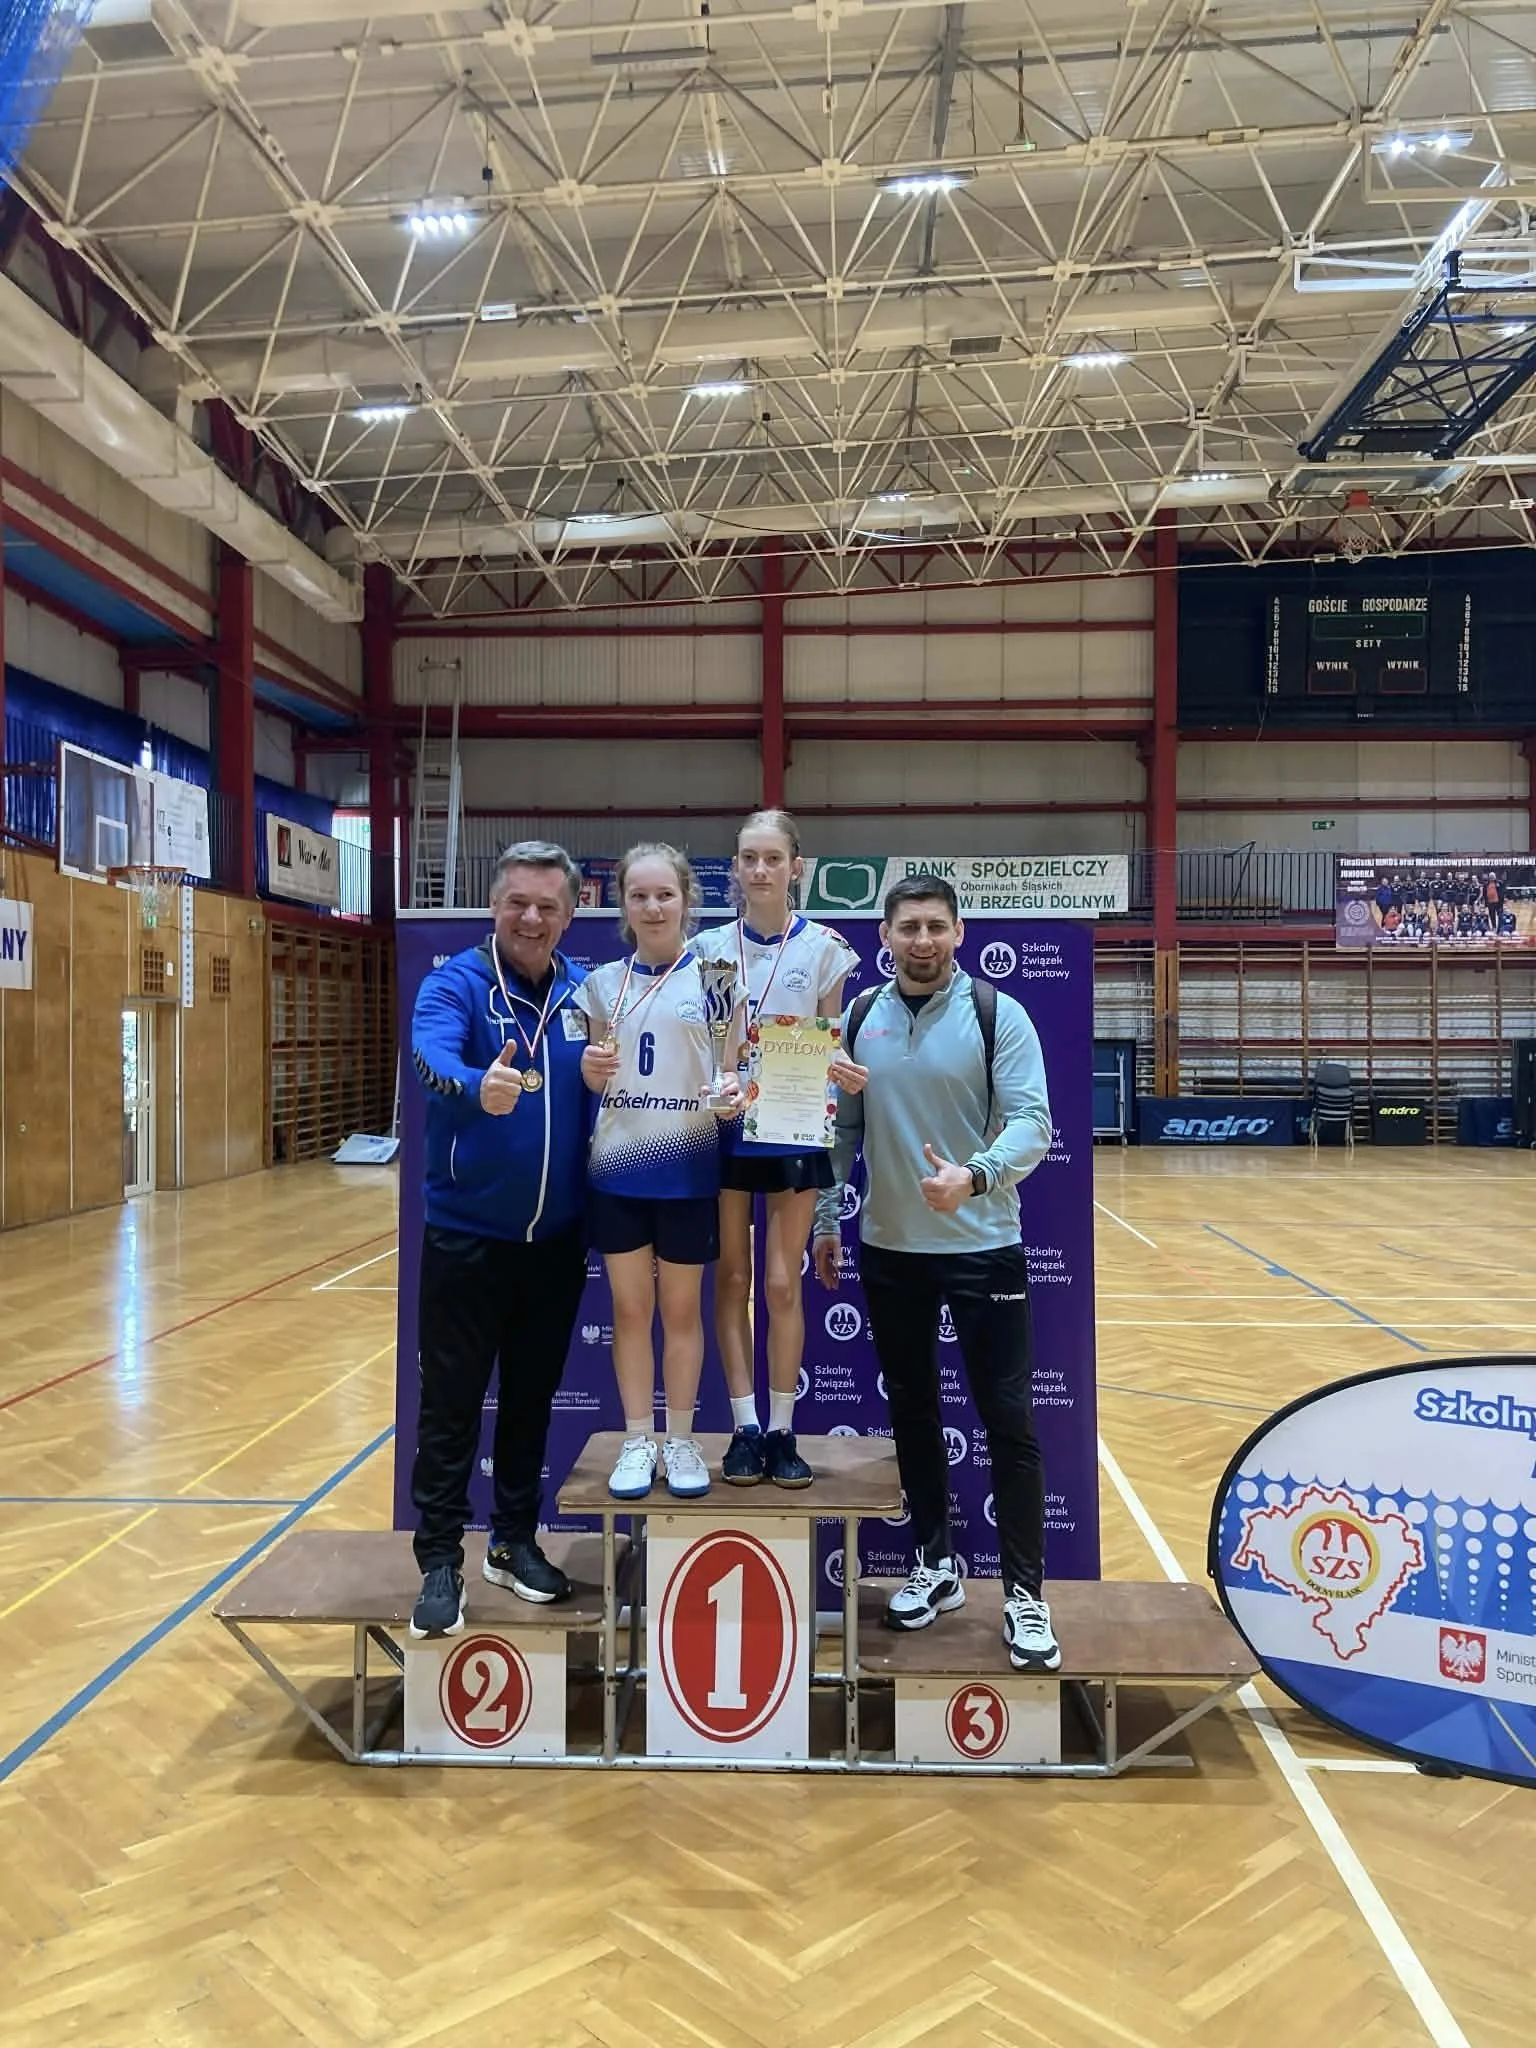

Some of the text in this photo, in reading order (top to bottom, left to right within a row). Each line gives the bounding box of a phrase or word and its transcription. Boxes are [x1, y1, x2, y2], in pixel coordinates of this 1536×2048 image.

[1308, 596, 1428, 613] GOŚCIE GOSPODARZE
[1356, 640, 1382, 648] SETY
[1316, 660, 1420, 671] WYNIK WYNIK
[905, 859, 1108, 878] BANK SPÓŁDZIELCZY
[961, 879, 1063, 892] Obornikach Śląskich
[960, 895, 1116, 909] W BRZEGU DOLNYM
[0, 927, 27, 961] NY
[1021, 943, 1060, 952] Szkolny
[987, 961, 1010, 973] SZS
[1021, 956, 1063, 967] Związek
[1021, 968, 1070, 979] Sportowy
[638, 1031, 656, 1076] 6
[764, 1040, 826, 1056] DYPLOM
[1379, 1107, 1420, 1115] andro
[1162, 1116, 1269, 1137] andro
[1024, 1247, 1062, 1258] Szkolny
[833, 1323, 855, 1334] SZS
[815, 1366, 852, 1376] Szkolny
[1032, 1369, 1064, 1380] zkolny
[815, 1379, 855, 1391] Związek
[1032, 1382, 1067, 1394] wiązek
[815, 1392, 862, 1404] Sportowy
[1032, 1396, 1074, 1407] portowy
[1045, 1494, 1065, 1505] olny
[867, 1552, 906, 1562] Szkolny
[867, 1565, 909, 1576] Związek
[1309, 1556, 1363, 1579] SZS
[707, 1564, 747, 1709] 1
[461, 1650, 508, 1732] 2
[963, 1695, 996, 1759] 3
